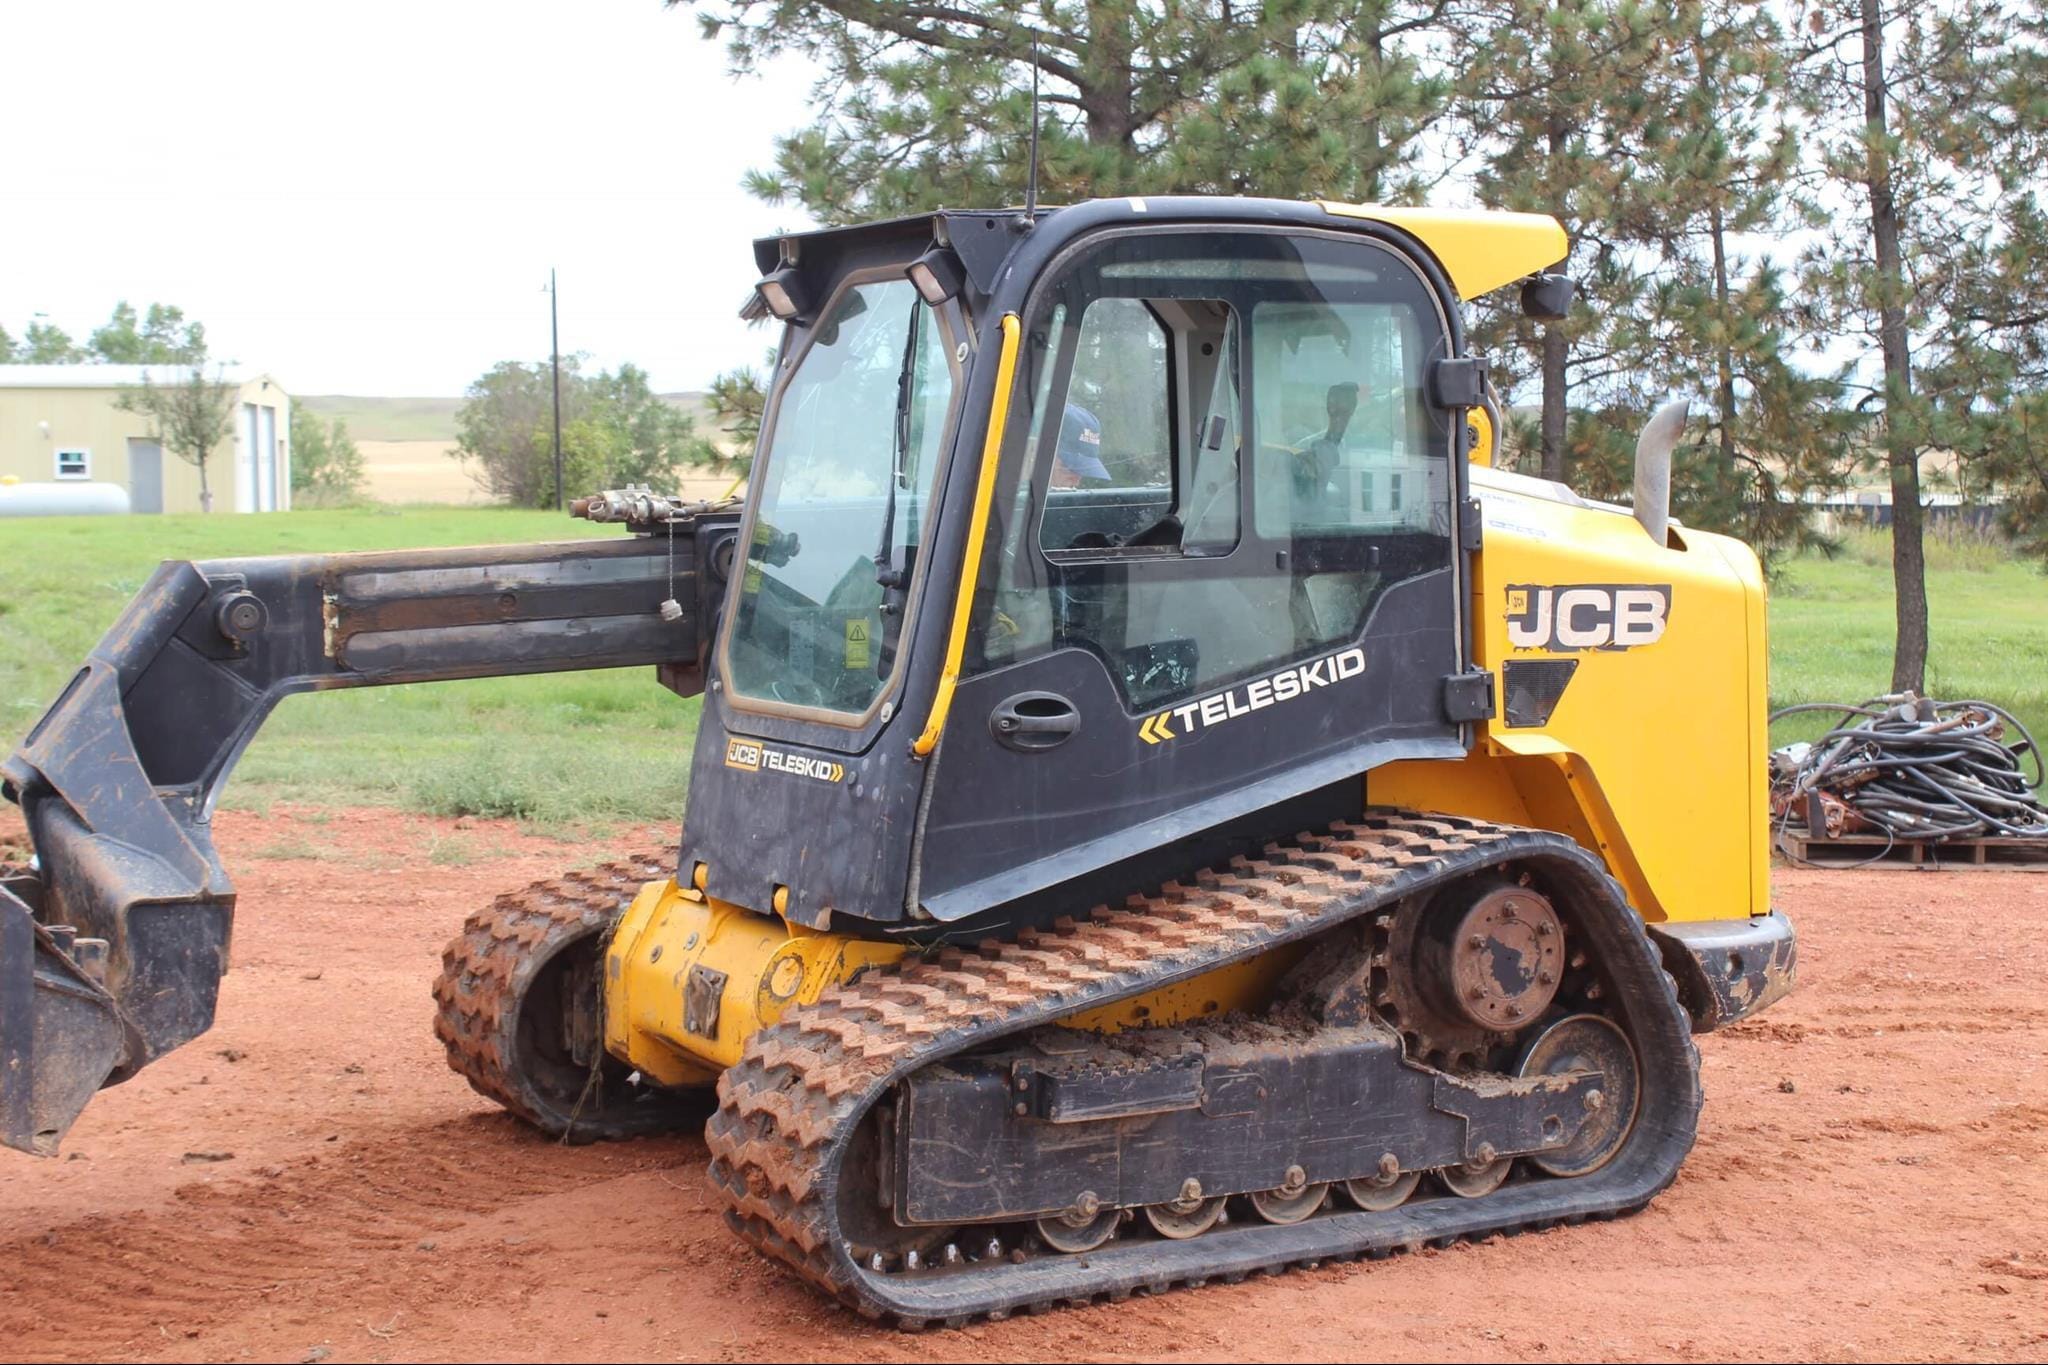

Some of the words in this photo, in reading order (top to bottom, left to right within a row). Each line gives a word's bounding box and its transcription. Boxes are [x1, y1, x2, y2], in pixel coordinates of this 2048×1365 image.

[1507, 589, 1667, 647] JCB
[1173, 648, 1366, 733] TELESKID
[729, 743, 759, 765] JCB
[761, 750, 832, 780] TELESKID
